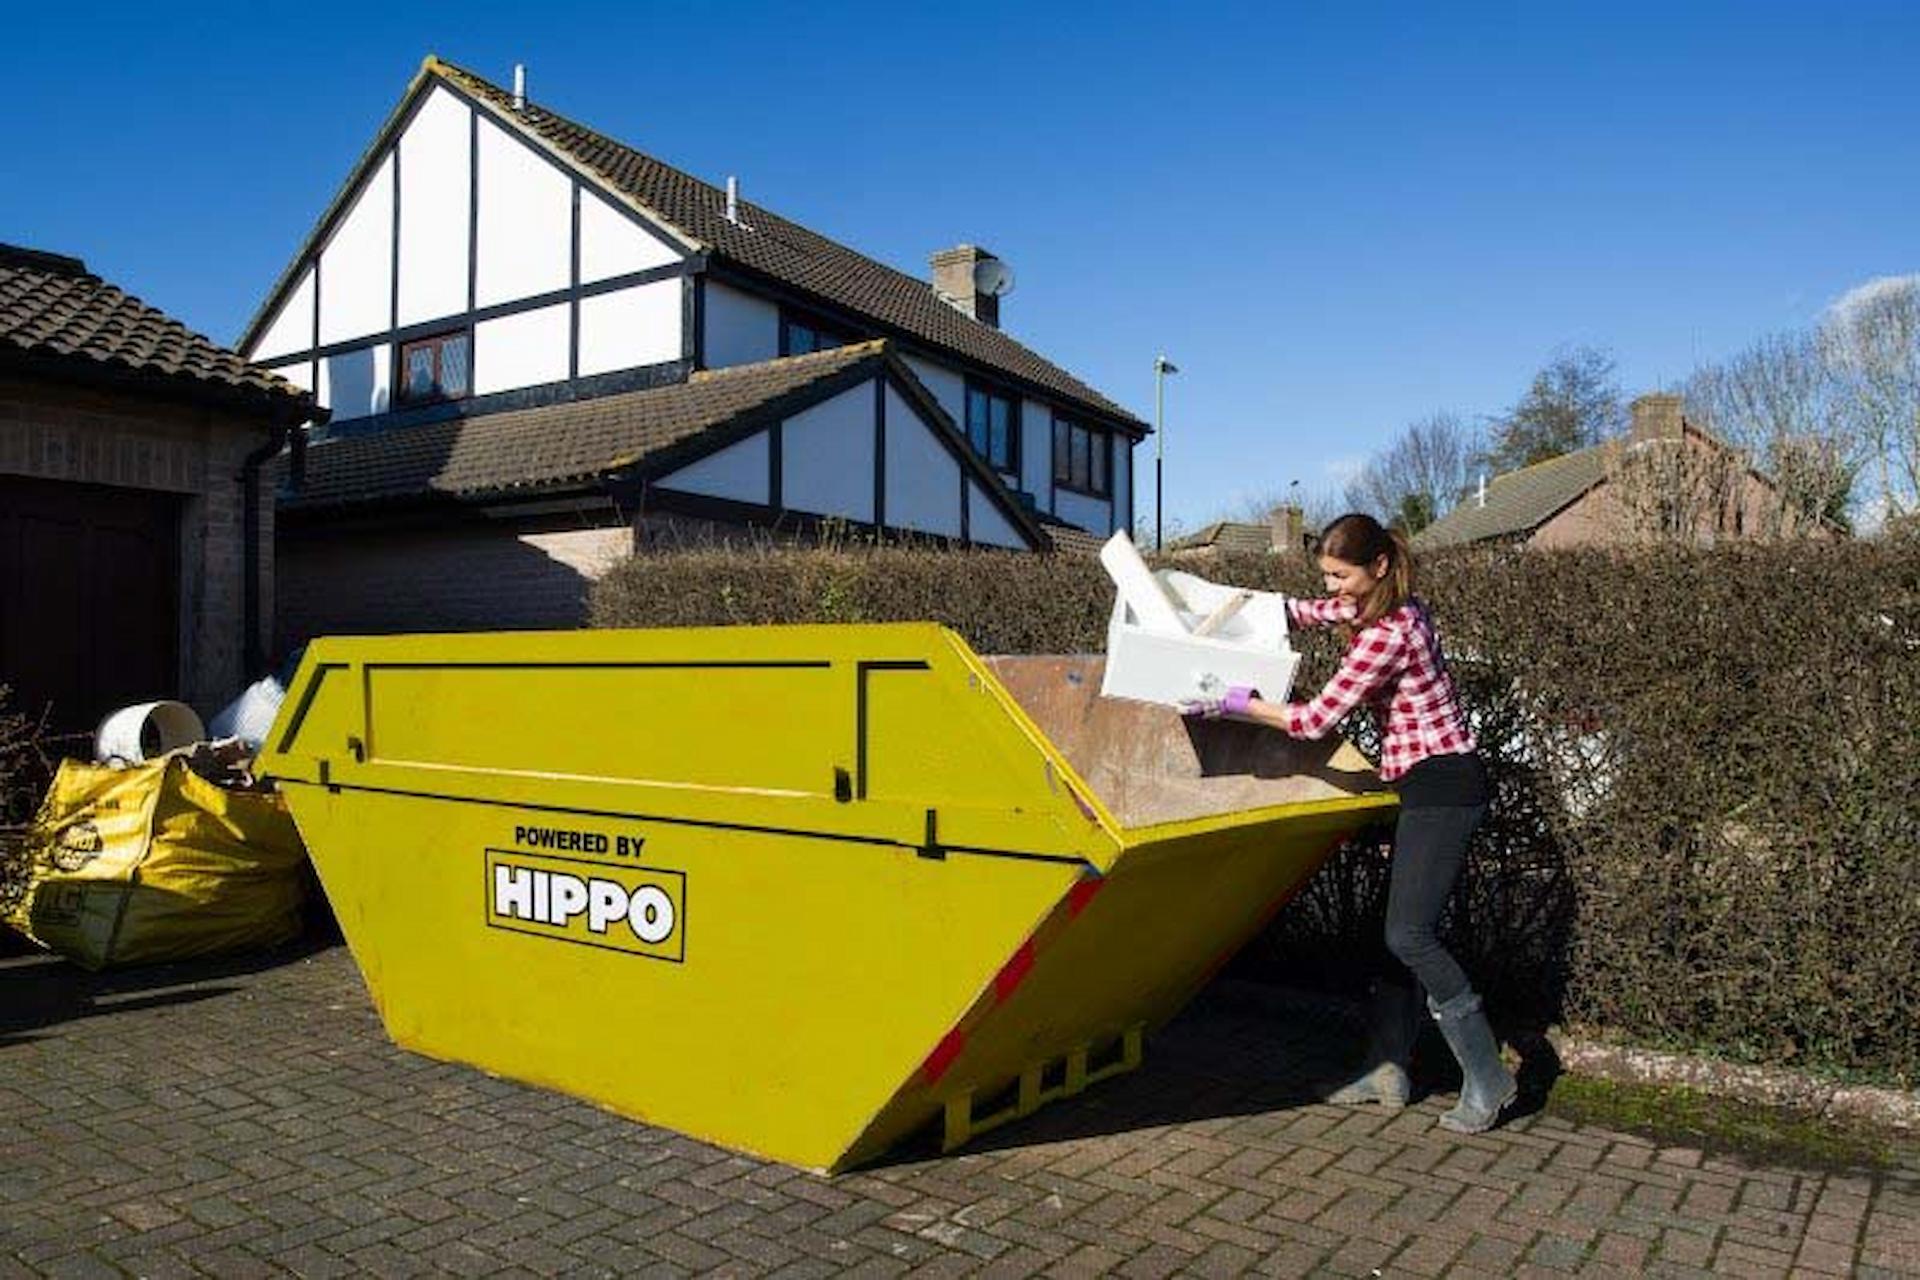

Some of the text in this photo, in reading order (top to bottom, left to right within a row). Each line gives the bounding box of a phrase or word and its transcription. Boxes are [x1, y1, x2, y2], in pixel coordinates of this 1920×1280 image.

[515, 826, 645, 857] POWERED BY
[494, 864, 675, 944] HIPPO
